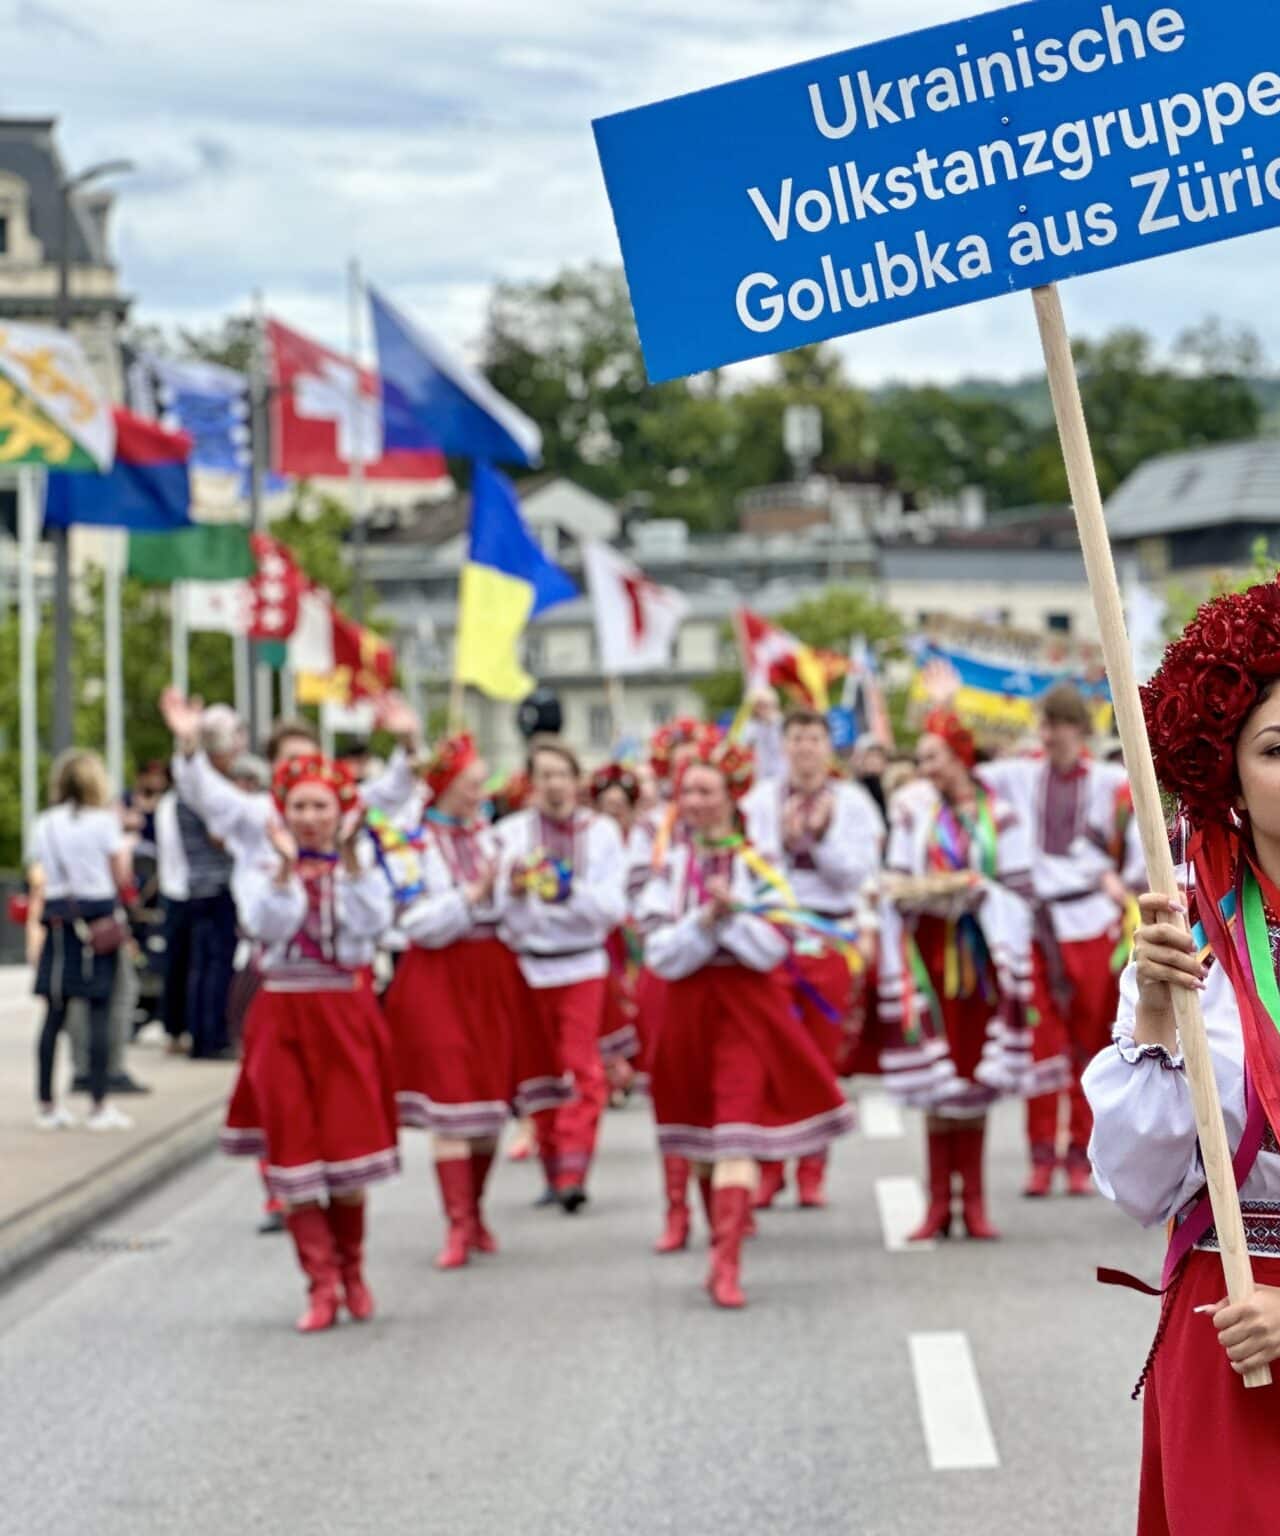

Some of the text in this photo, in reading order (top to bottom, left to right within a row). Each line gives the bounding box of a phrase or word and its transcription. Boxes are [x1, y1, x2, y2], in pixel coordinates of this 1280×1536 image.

[807, 4, 1185, 139] Ukrainische
[735, 230, 992, 333] Golubka
[1007, 202, 1118, 266] aus
